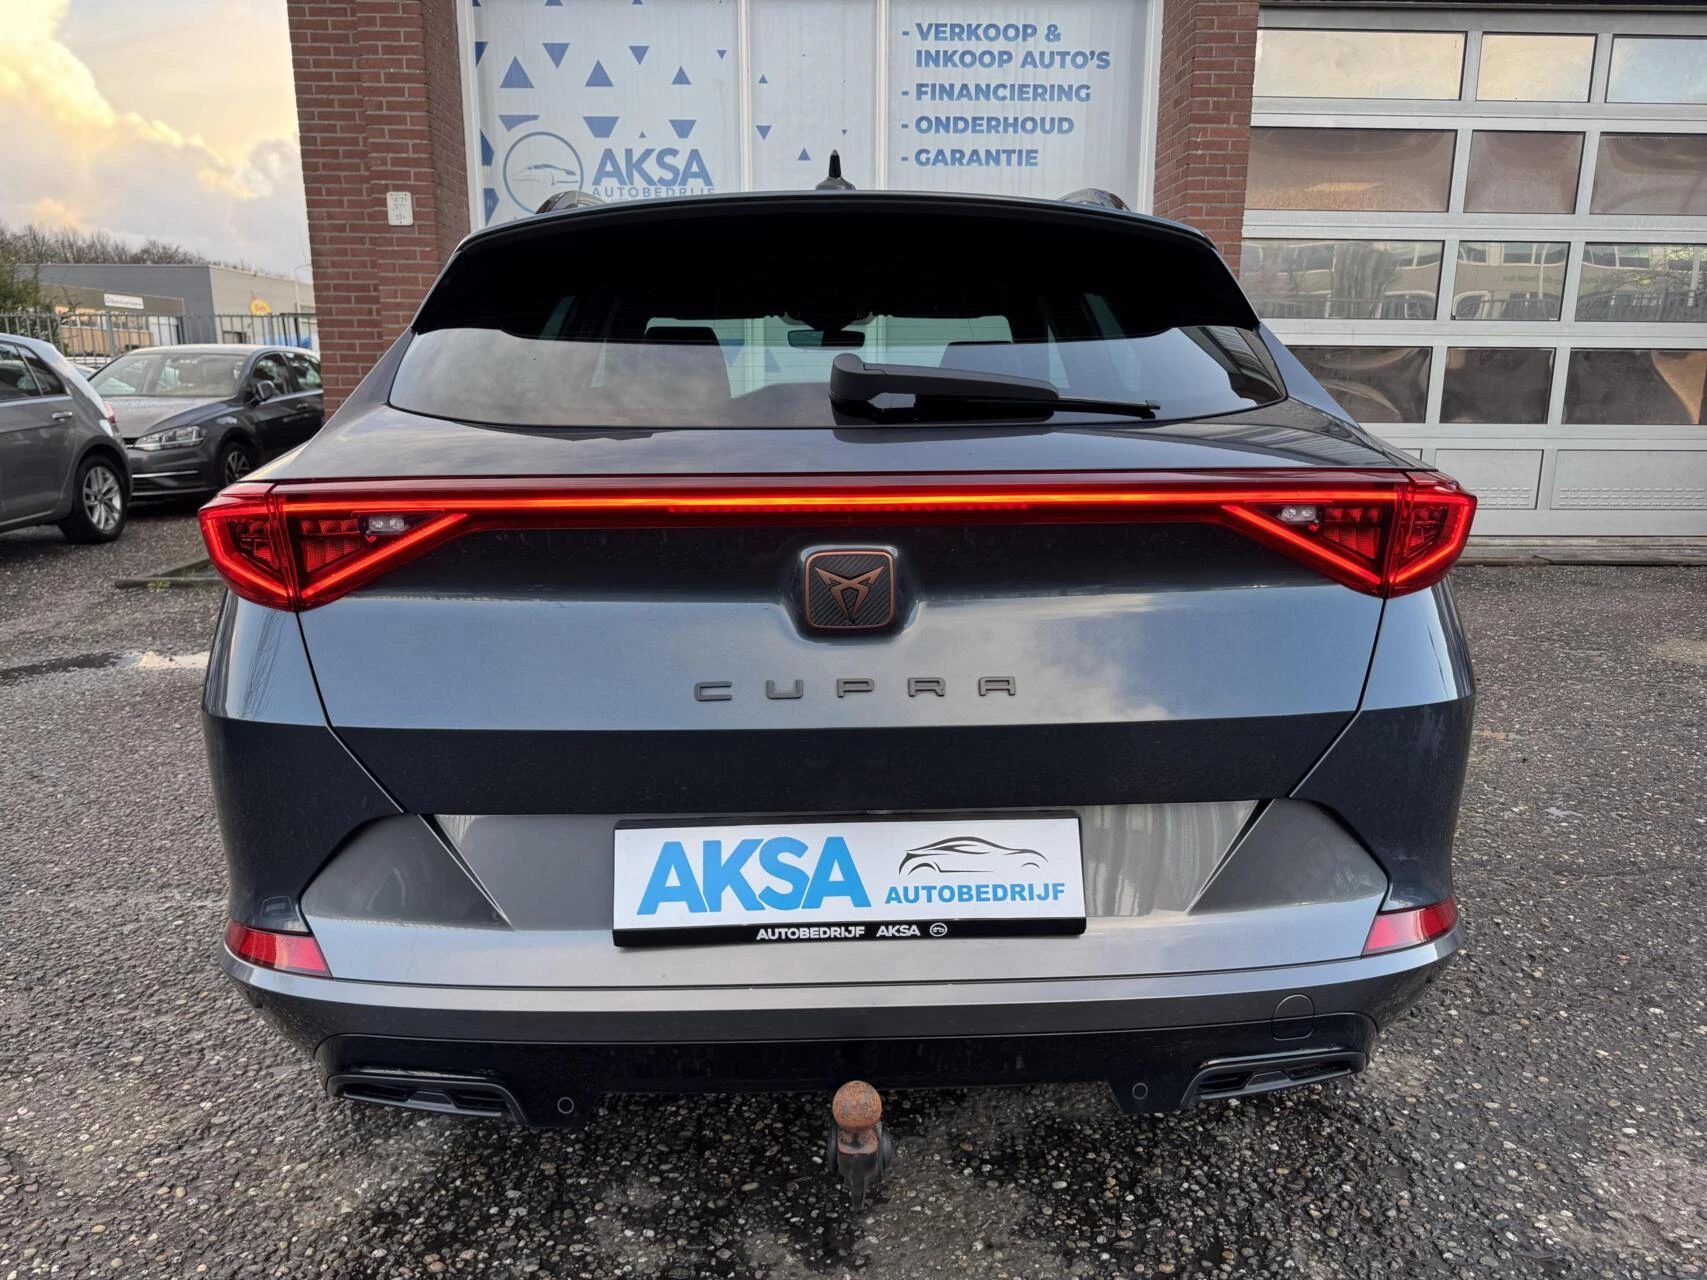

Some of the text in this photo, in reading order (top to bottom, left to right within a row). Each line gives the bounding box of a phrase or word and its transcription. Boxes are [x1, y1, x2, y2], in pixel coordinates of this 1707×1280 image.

[915, 23, 1038, 41] VERKOOP
[1044, 23, 1062, 42] &
[915, 49, 1111, 69] INKOOP AUTO'S
[915, 83, 1092, 102] FINANCIERING
[914, 116, 1075, 134] ONDERHOUD
[592, 147, 714, 187] AKSA
[914, 148, 1039, 167] GARANTIE
[694, 675, 1017, 702] CUPRA
[636, 835, 872, 916] AKSA
[884, 882, 1066, 905] AUTOBEDRIJF
[755, 924, 921, 940] AUTOBEDRIJF AKSA
